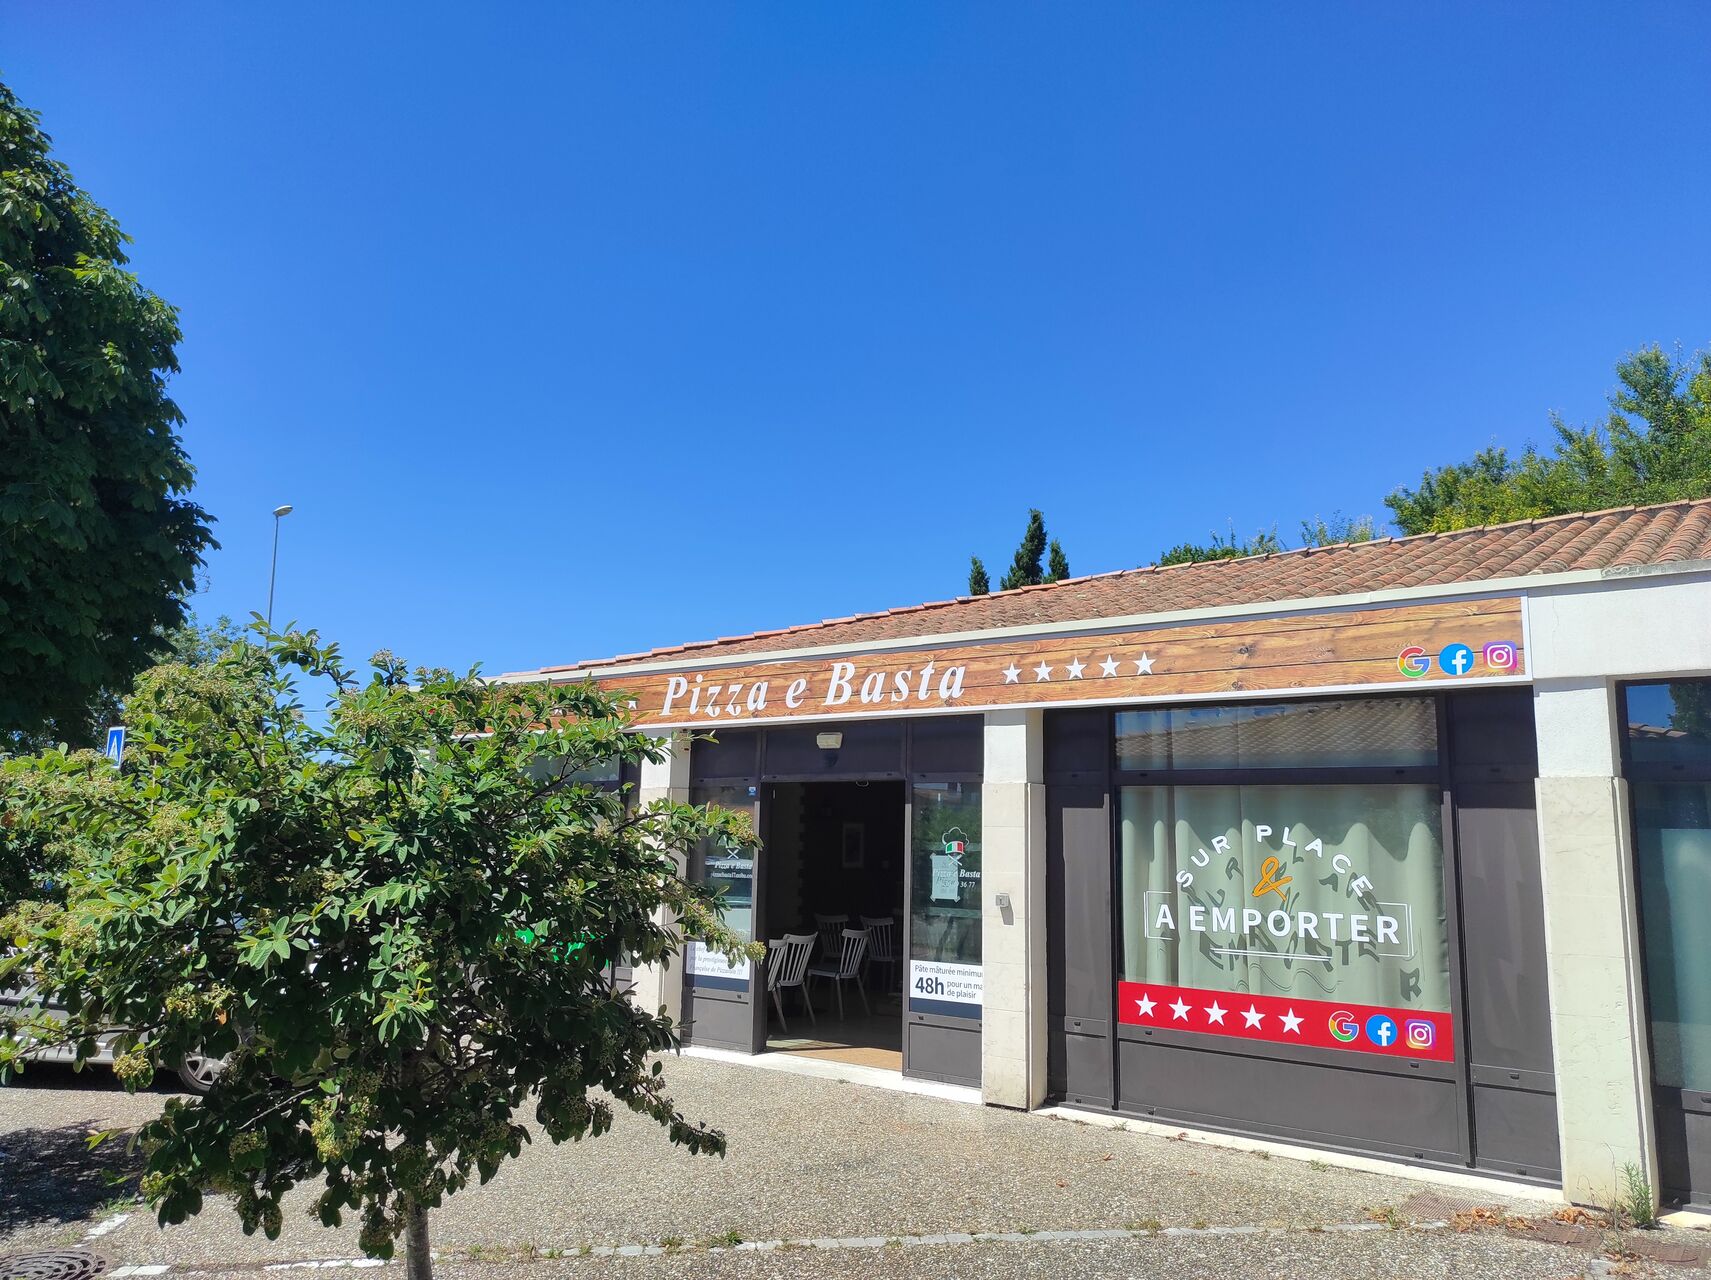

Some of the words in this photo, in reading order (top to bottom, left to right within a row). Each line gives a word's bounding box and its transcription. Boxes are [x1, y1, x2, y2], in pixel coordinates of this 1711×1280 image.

[658, 674, 768, 718] Pizza
[785, 678, 807, 709] e
[821, 661, 966, 706] Basta
[1176, 835, 1231, 888] SUR
[1256, 825, 1374, 897] PLACE
[959, 868, 981, 878] Basta
[1155, 904, 1175, 930] A
[1189, 905, 1399, 945] EMPORTER
[914, 964, 929, 973] Pâte
[929, 966, 956, 976] mâturée
[915, 976, 944, 995] 48h
[947, 981, 962, 989] pour
[946, 989, 955, 997] de
[956, 991, 977, 999] plaisir
